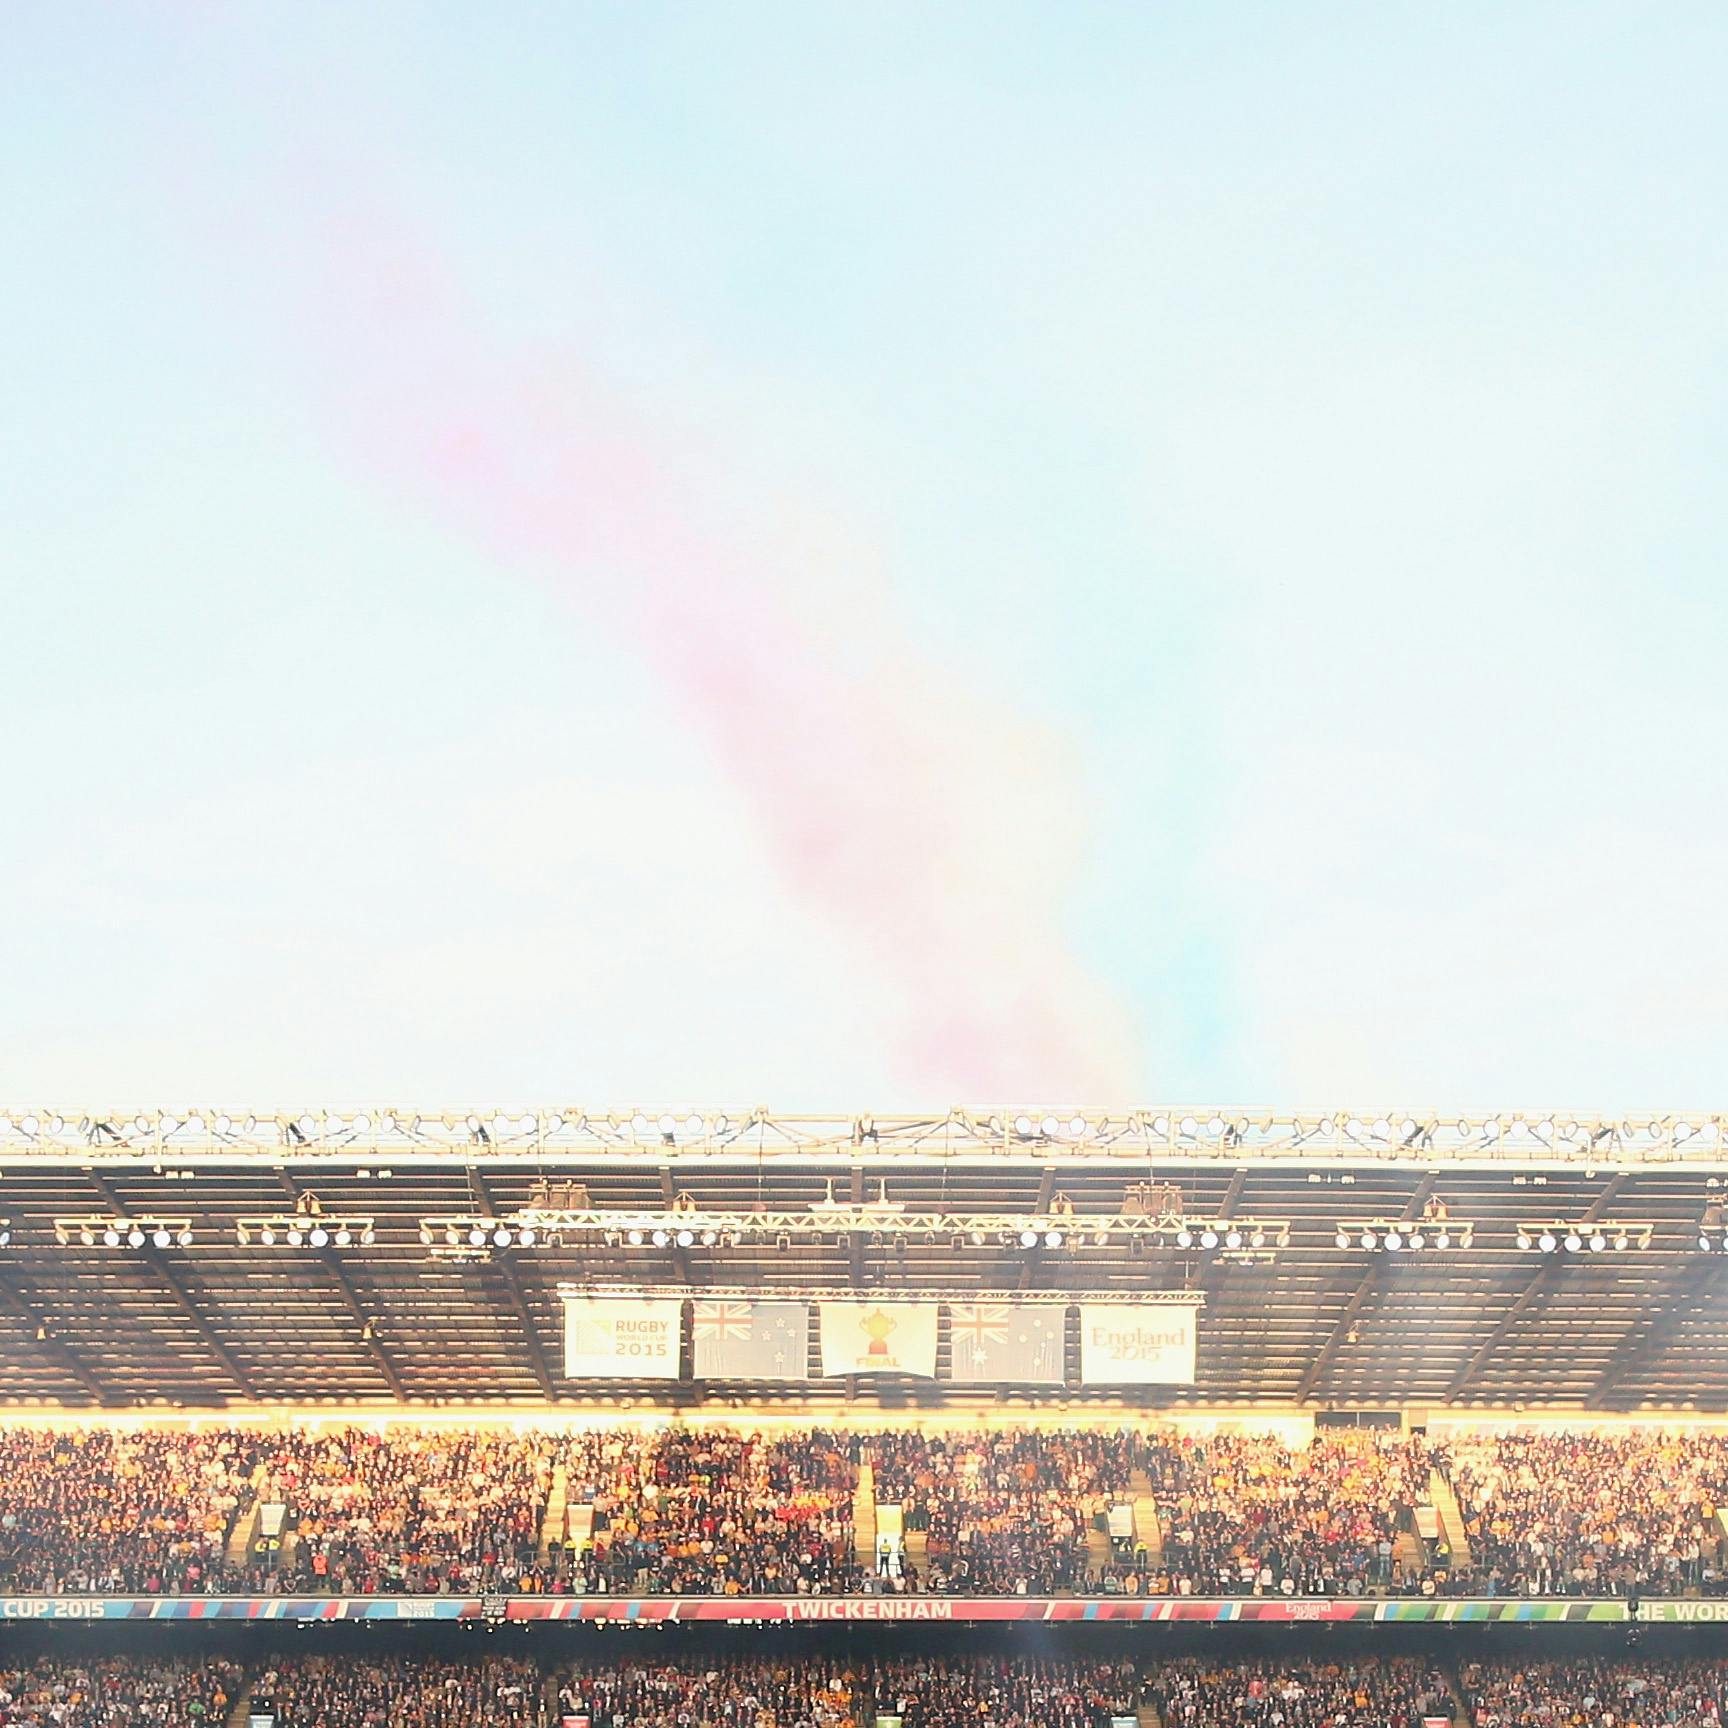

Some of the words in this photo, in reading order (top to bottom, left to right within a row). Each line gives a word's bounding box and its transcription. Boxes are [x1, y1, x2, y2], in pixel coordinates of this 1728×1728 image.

[615, 1320, 669, 1333] RUGBY
[1093, 1327, 1184, 1348] England
[615, 1343, 667, 1356] 2015
[1111, 1346, 1161, 1360] 2015
[856, 1357, 901, 1368] FINAL
[3, 1601, 49, 1618] CUP
[54, 1601, 105, 1618] 2015
[781, 1602, 952, 1619] TWICKENHAM
[1285, 1601, 1331, 1615] England
